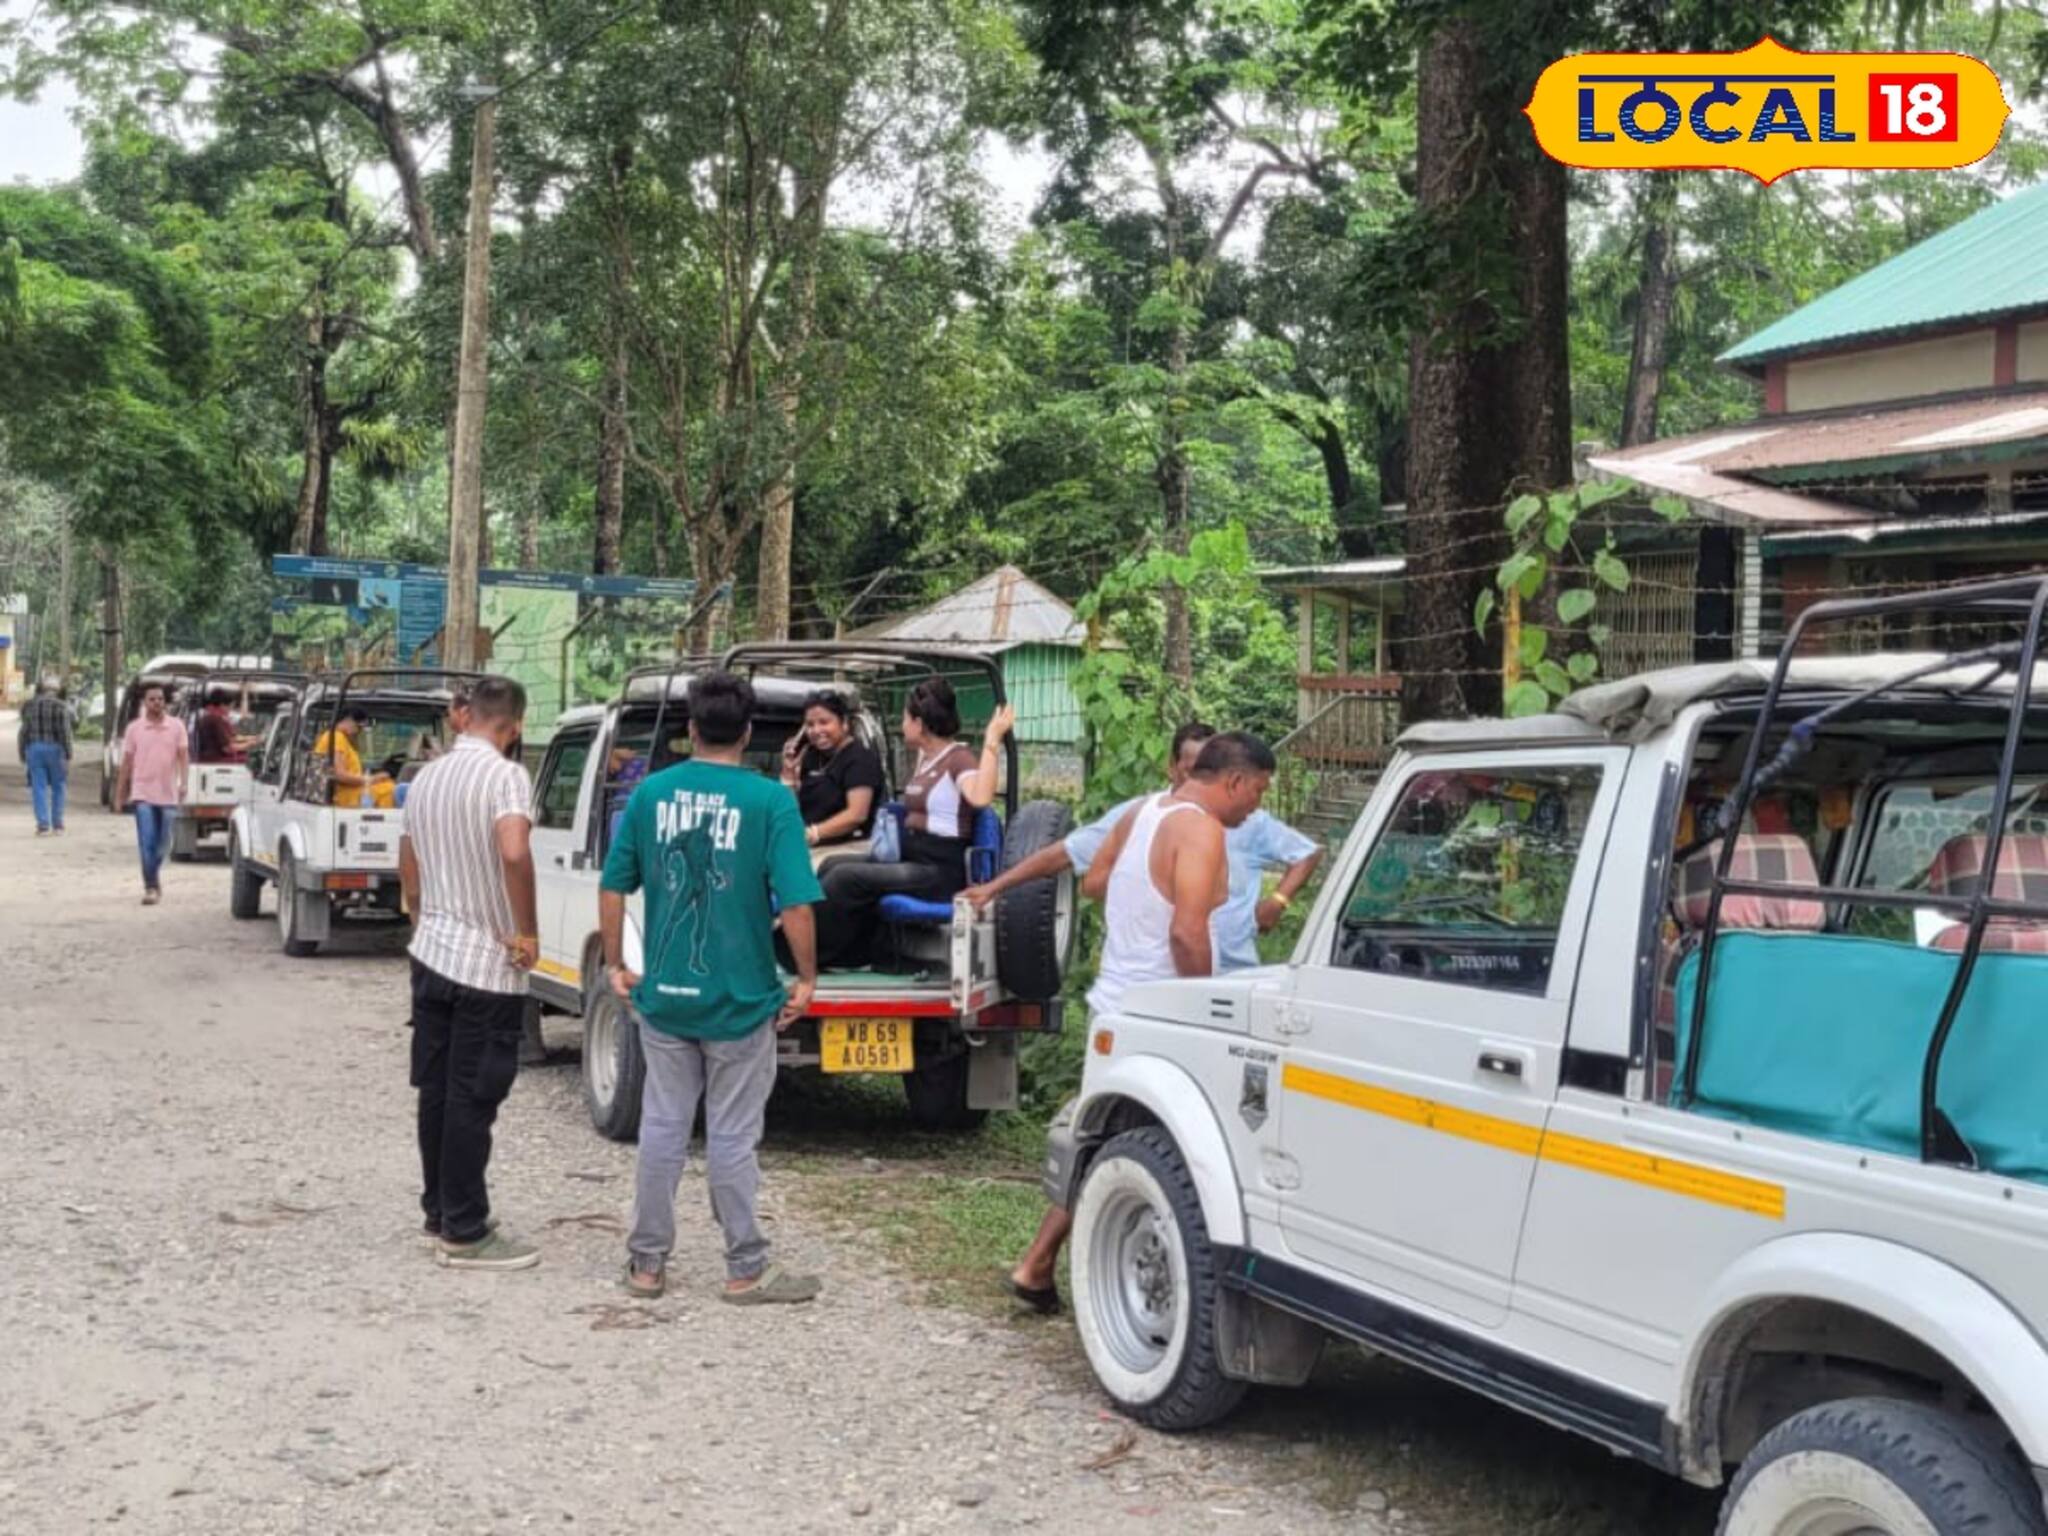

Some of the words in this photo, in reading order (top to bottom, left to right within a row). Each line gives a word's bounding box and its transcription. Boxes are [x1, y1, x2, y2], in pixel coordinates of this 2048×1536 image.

[674, 789, 693, 803] THE
[695, 792, 727, 806] BLACK
[847, 1023, 868, 1042] WB
[876, 1023, 897, 1042] 69
[842, 1045, 900, 1065] A0581
